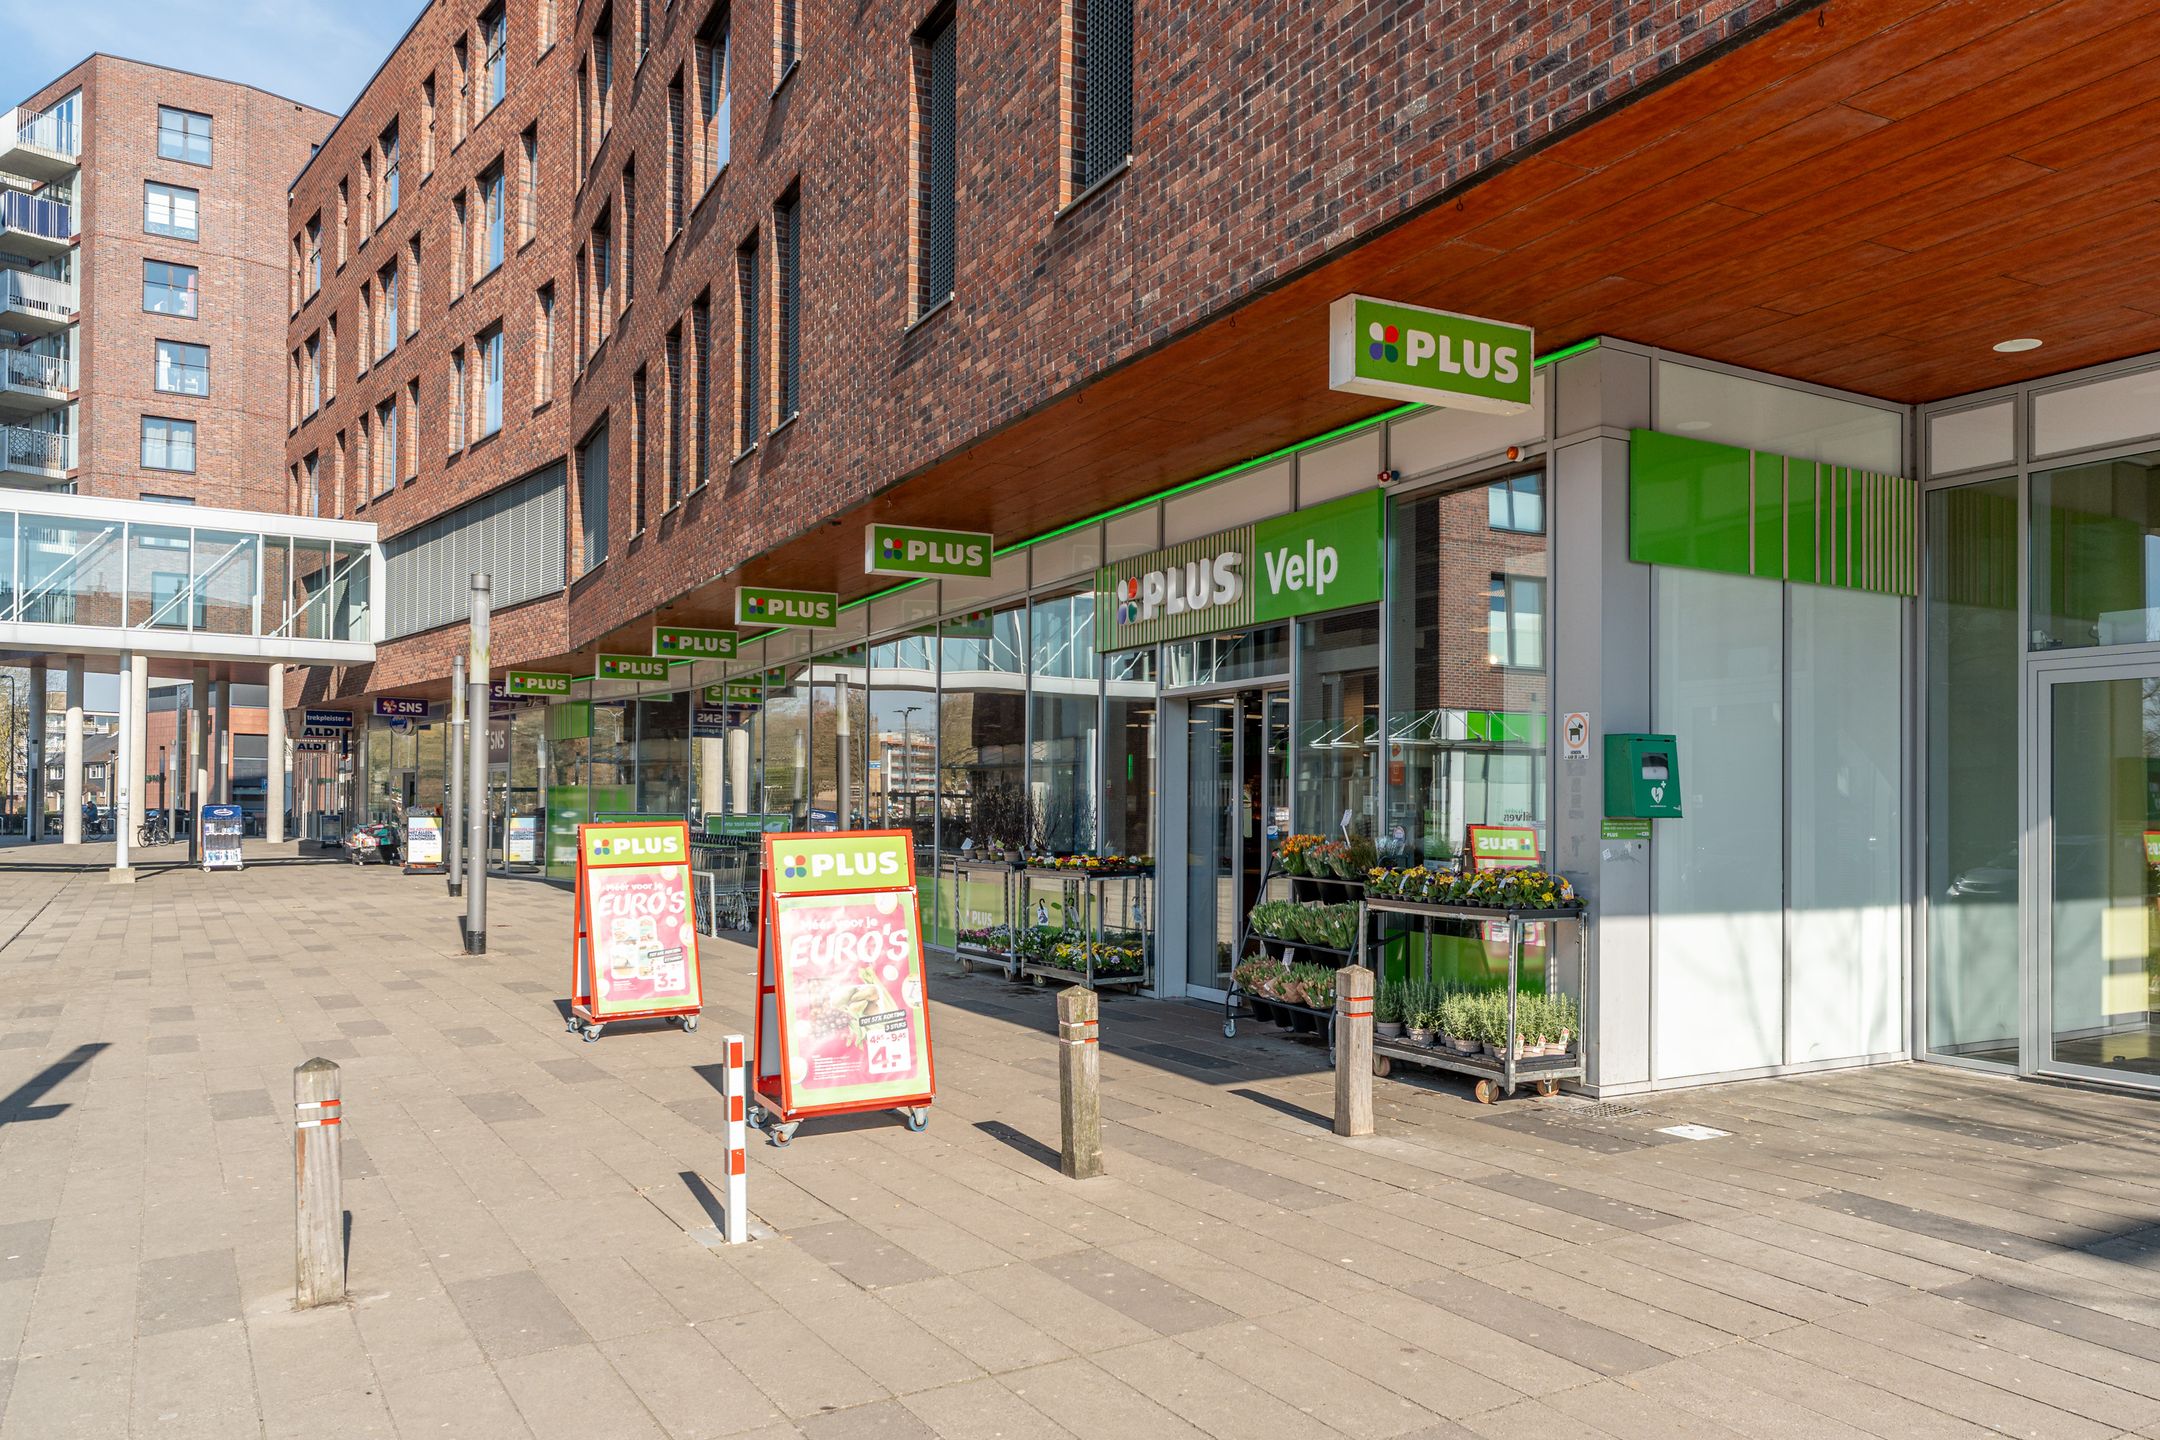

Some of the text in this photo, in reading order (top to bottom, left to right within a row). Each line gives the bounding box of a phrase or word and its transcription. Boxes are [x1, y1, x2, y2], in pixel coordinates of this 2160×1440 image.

[1406, 329, 1519, 384] PLUS
[908, 539, 984, 567] PLUS
[1142, 538, 1338, 621] PLUS Velp
[767, 598, 830, 619] PLUS
[679, 635, 731, 653] PLUS
[618, 661, 664, 676] PLUS
[527, 678, 567, 690] PLUS
[398, 702, 423, 713] SNS
[306, 714, 345, 722] trekpleister
[303, 727, 340, 737] ALDI
[490, 729, 505, 750] SNS
[614, 836, 679, 855] PLUS
[811, 851, 899, 877] PLUS
[631, 882, 653, 890] voor
[599, 887, 686, 917] EURO'S
[866, 916, 878, 928] je
[972, 911, 993, 927] PLUS
[790, 923, 910, 968] EURO'S
[861, 1017, 871, 1025] TOT
[890, 1021, 907, 1030] STUKS
